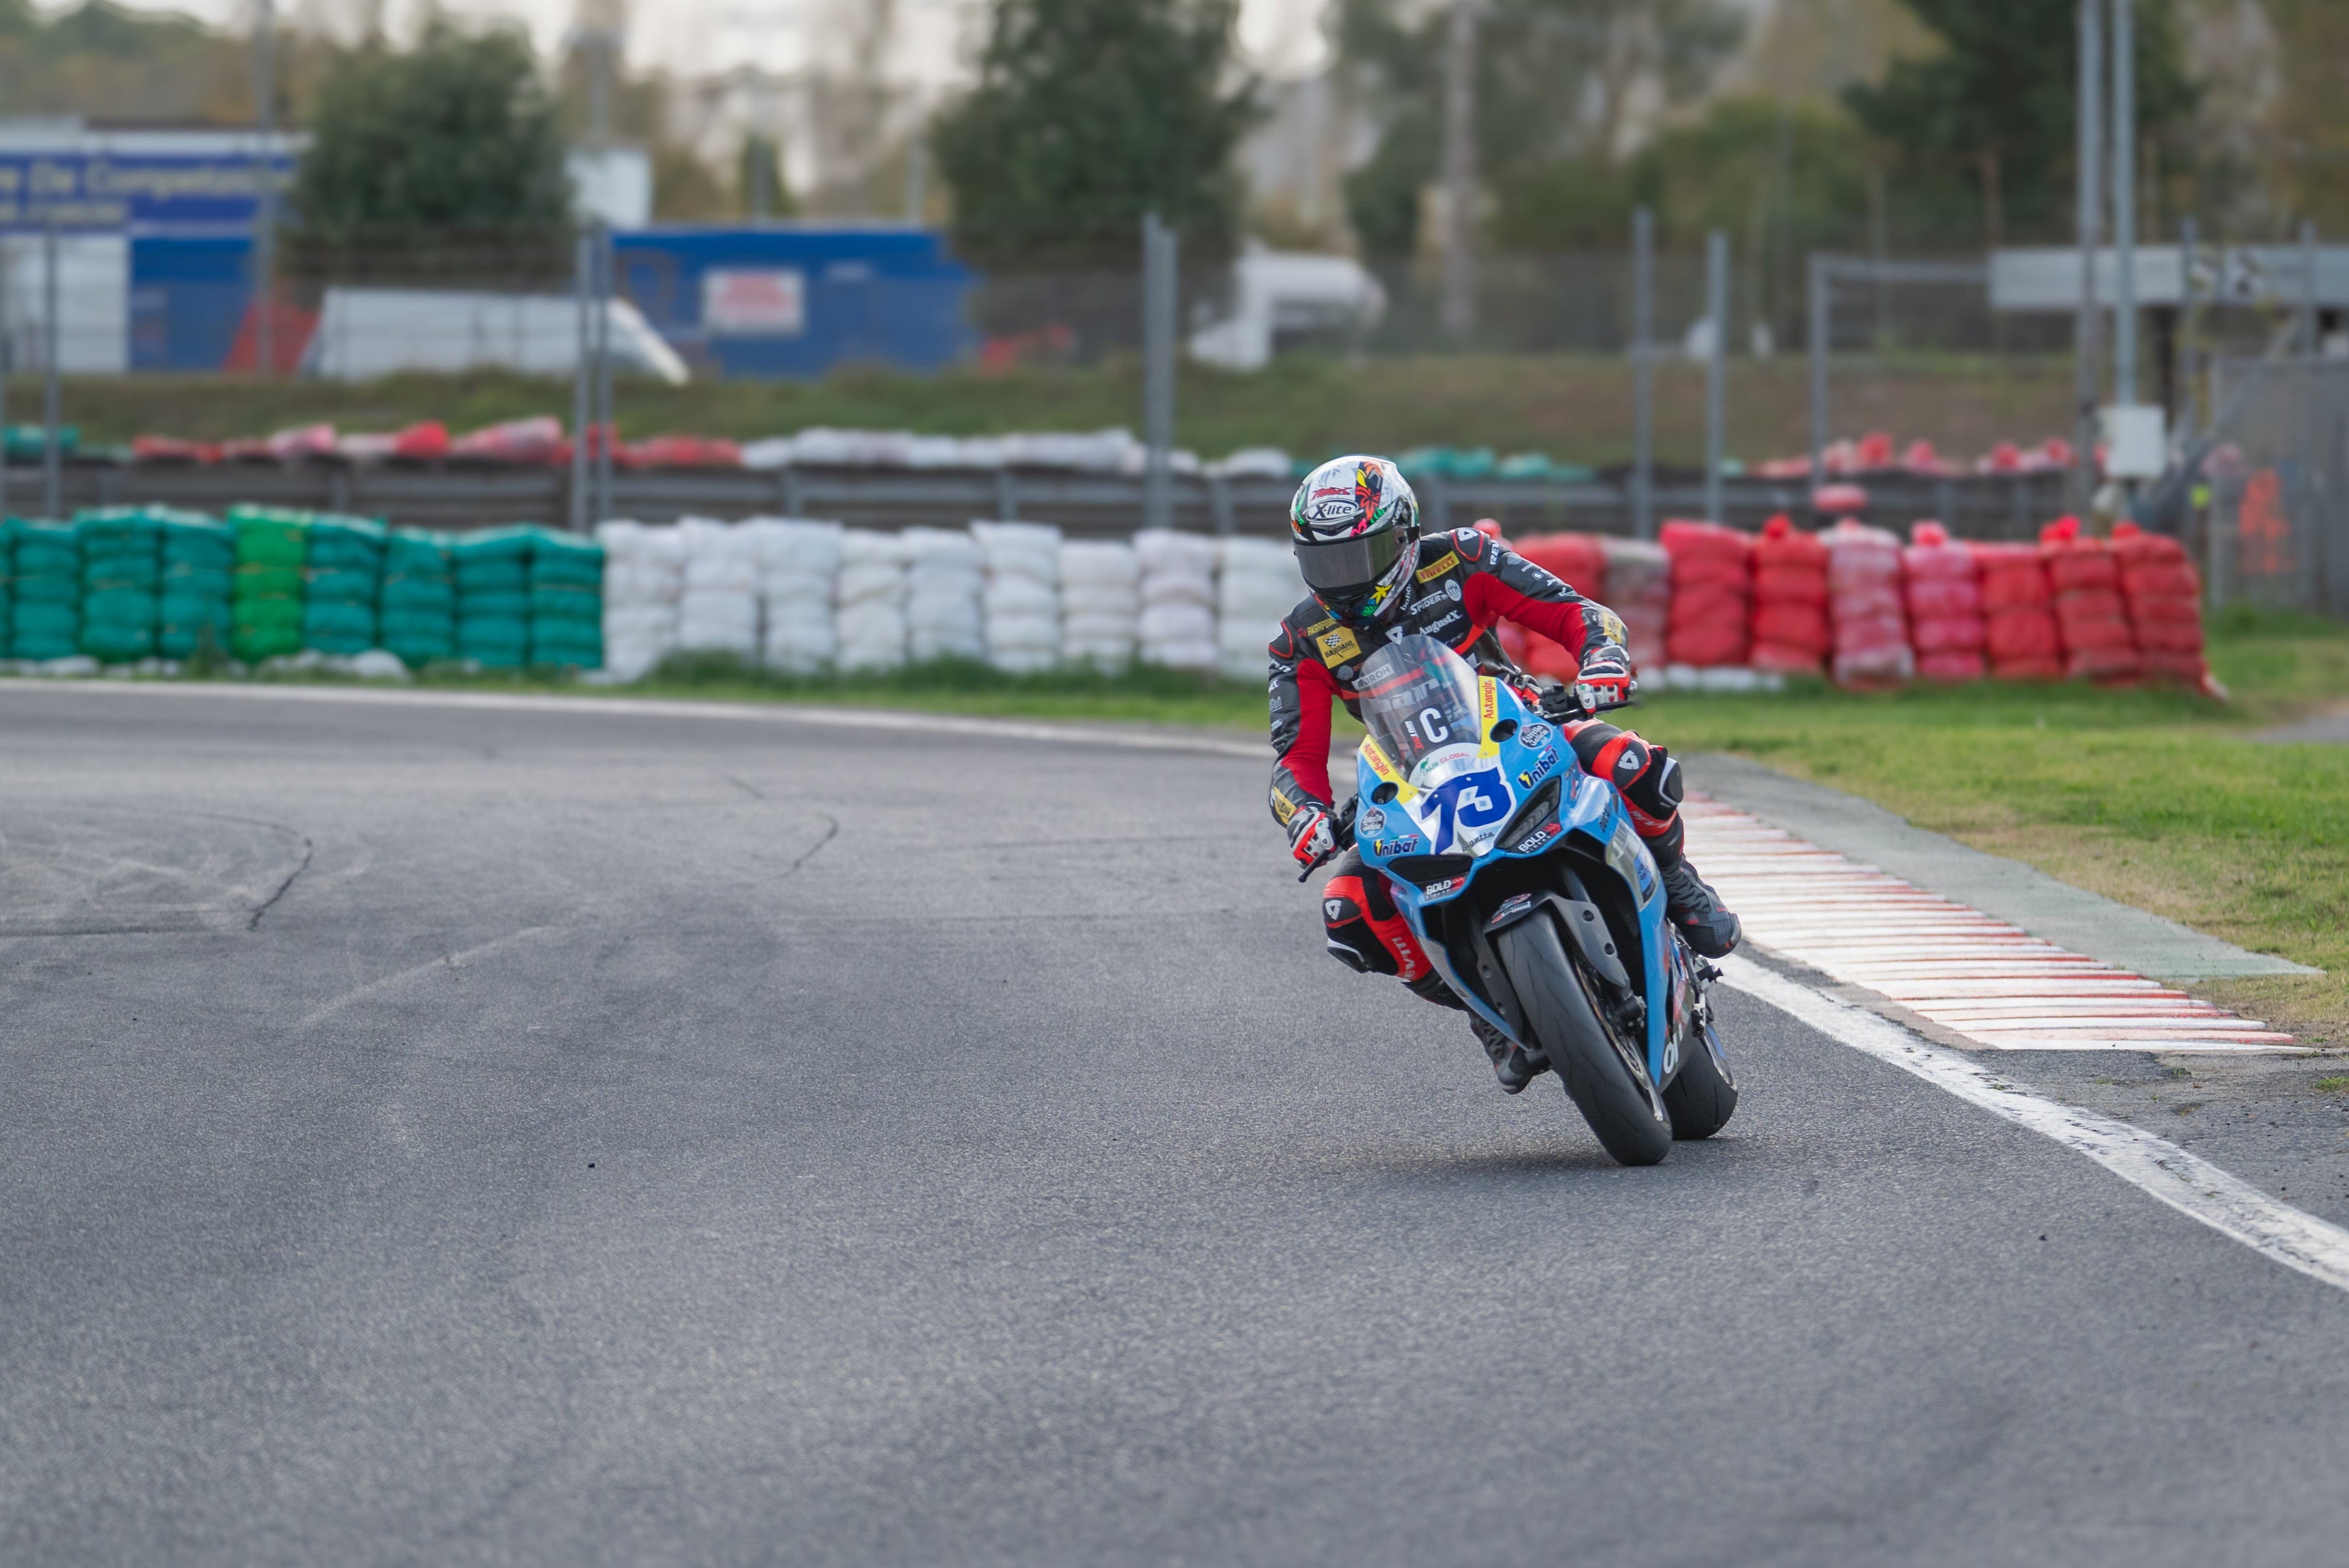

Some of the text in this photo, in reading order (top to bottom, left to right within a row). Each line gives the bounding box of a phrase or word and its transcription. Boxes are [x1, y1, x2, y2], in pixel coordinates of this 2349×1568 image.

[1312, 503, 1353, 519] X-lite
[1420, 555, 1455, 580] PIRELLI
[1409, 590, 1442, 615] SPIDER
[1324, 641, 1355, 658] BARDAHL
[1357, 667, 1390, 687] AIROH
[1483, 680, 1496, 719] Antangin
[1419, 708, 1449, 743] C
[1522, 724, 1543, 743] Estrella
[1528, 729, 1549, 746] Galicia
[1364, 744, 1389, 776] Antangin
[1439, 752, 1471, 764] GLOBAL
[1516, 748, 1559, 790] Unibat
[1420, 767, 1512, 855] 73
[1373, 838, 1419, 856] Unibat
[1518, 831, 1546, 852] BOLD
[1426, 880, 1452, 895] BOLD
